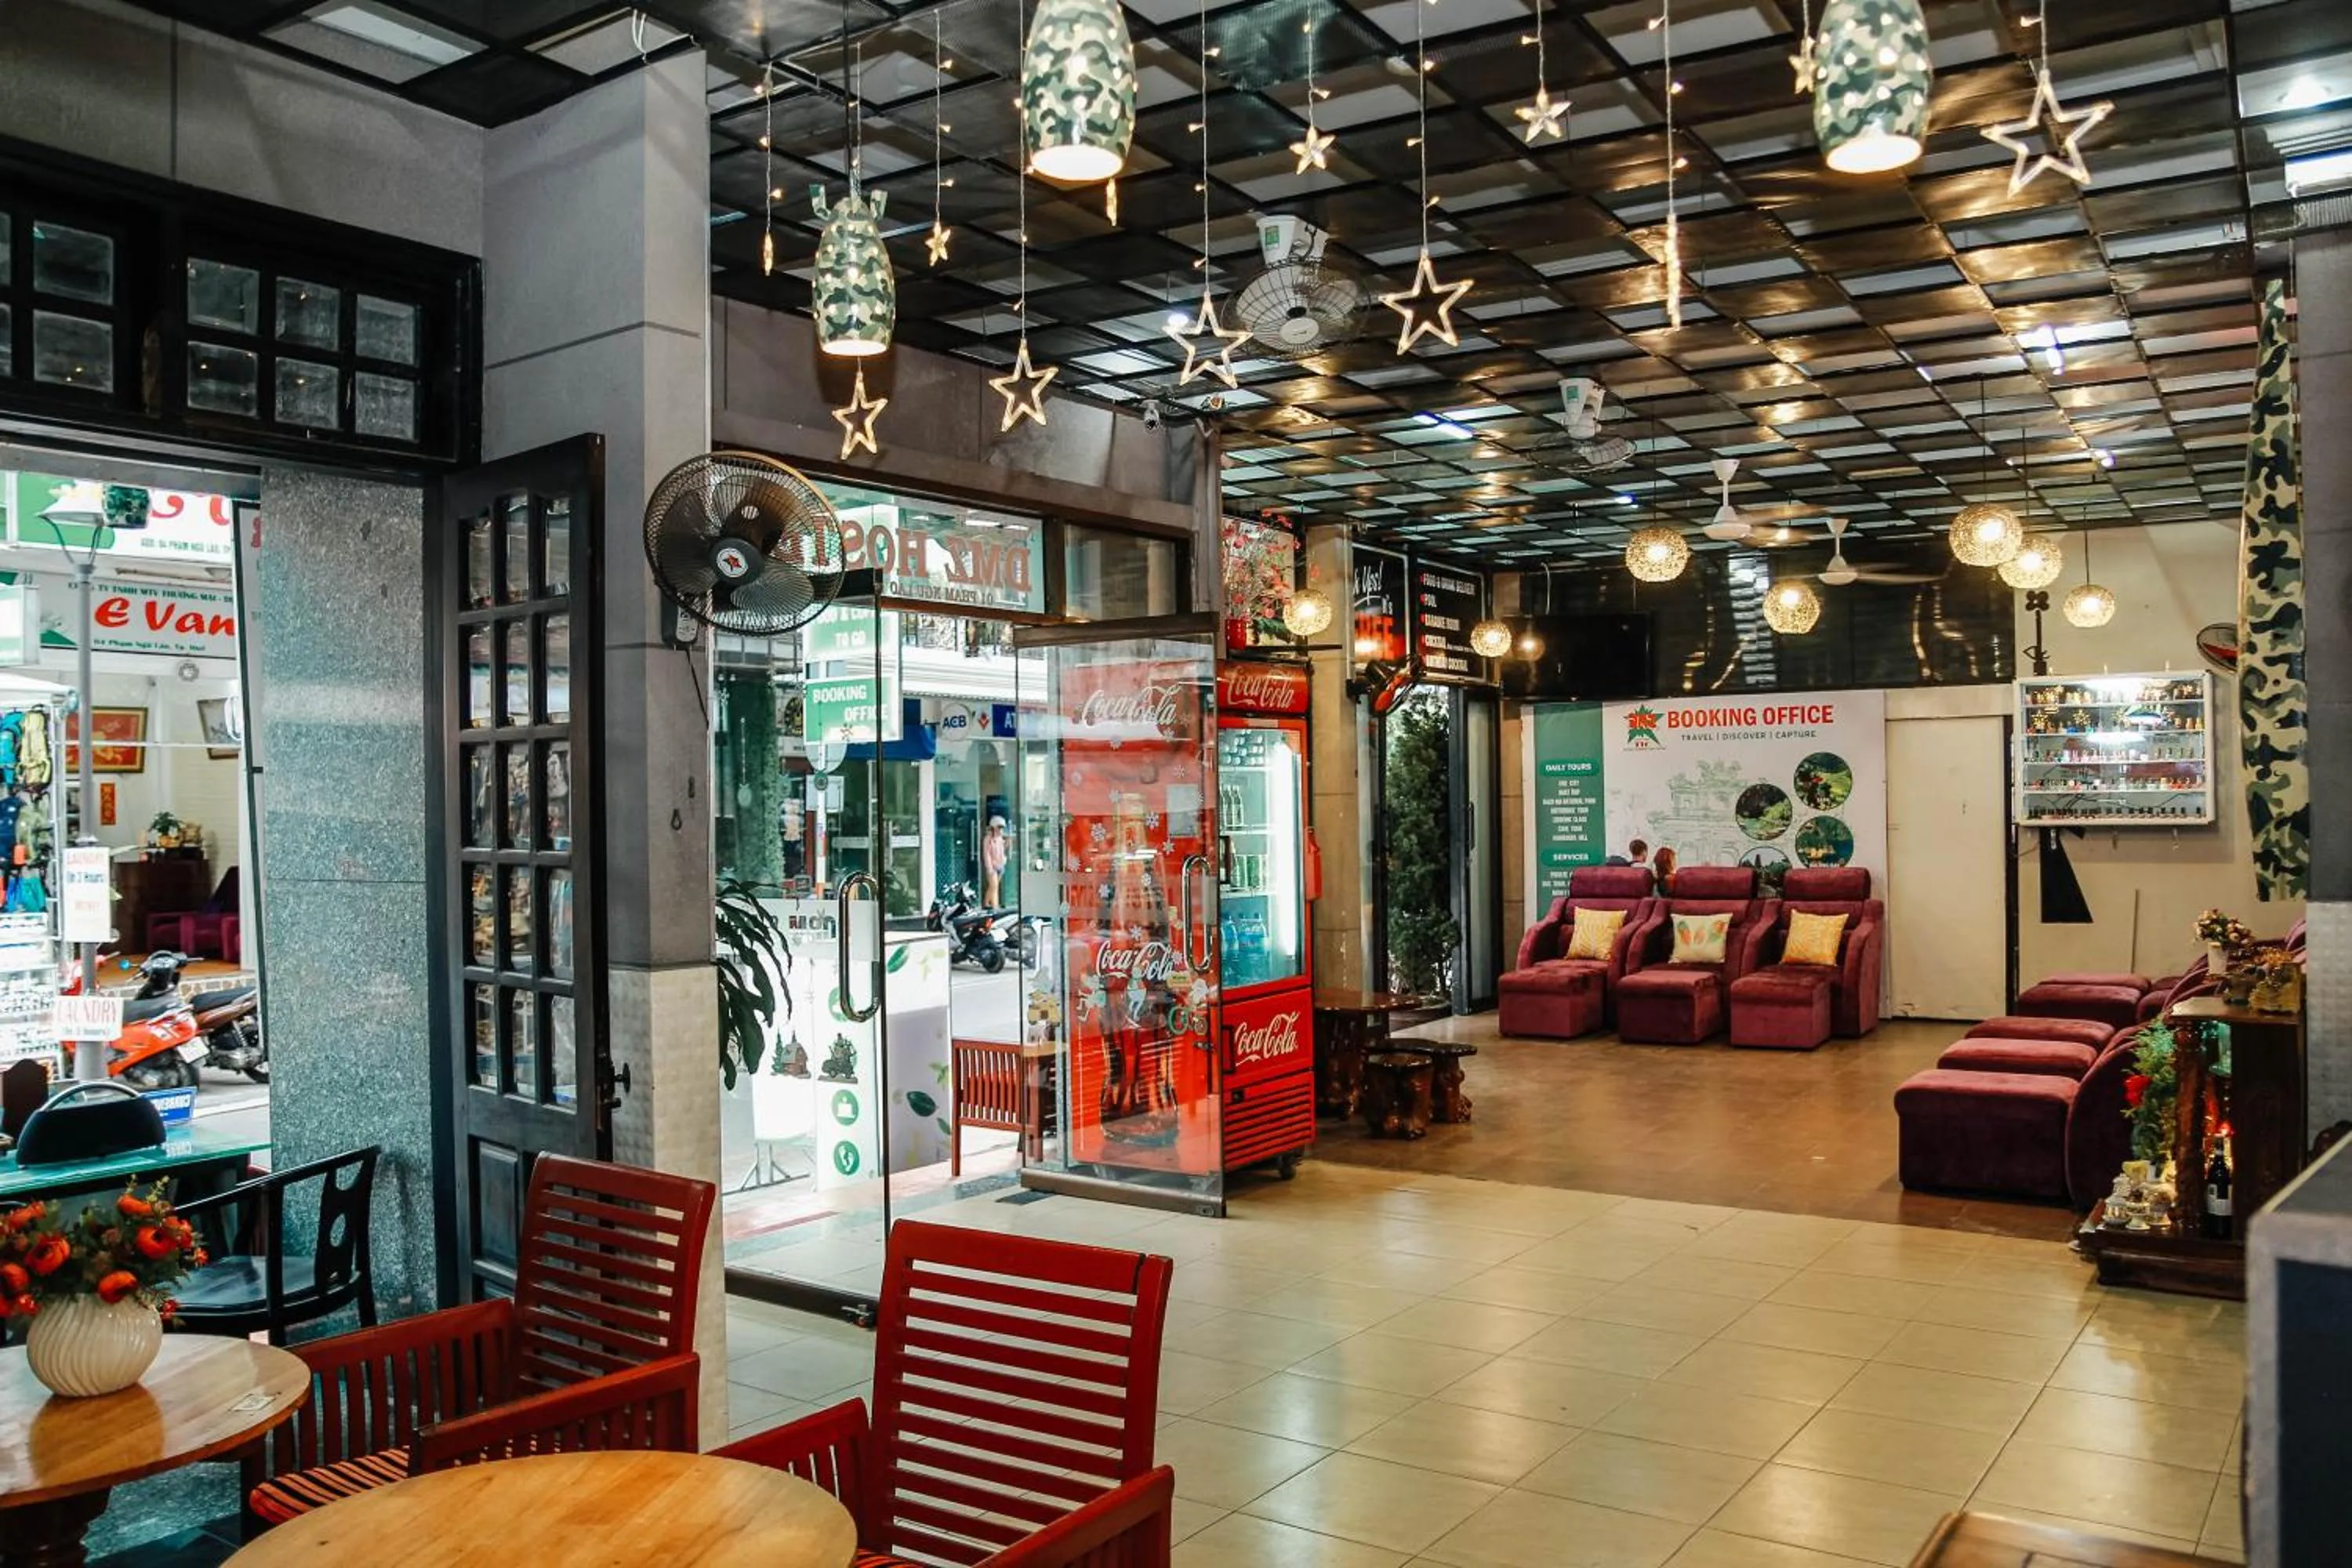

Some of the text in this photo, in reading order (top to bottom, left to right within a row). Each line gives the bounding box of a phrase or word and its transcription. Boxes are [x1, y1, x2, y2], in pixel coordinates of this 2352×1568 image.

[812, 684, 867, 703] BOOKING
[942, 714, 967, 729] ACB
[1667, 705, 1835, 728] BOOKING OFFICE
[1722, 731, 1766, 740] DISCOVER
[1774, 730, 1817, 739] CAPTURE
[1567, 763, 1592, 771] TOURS
